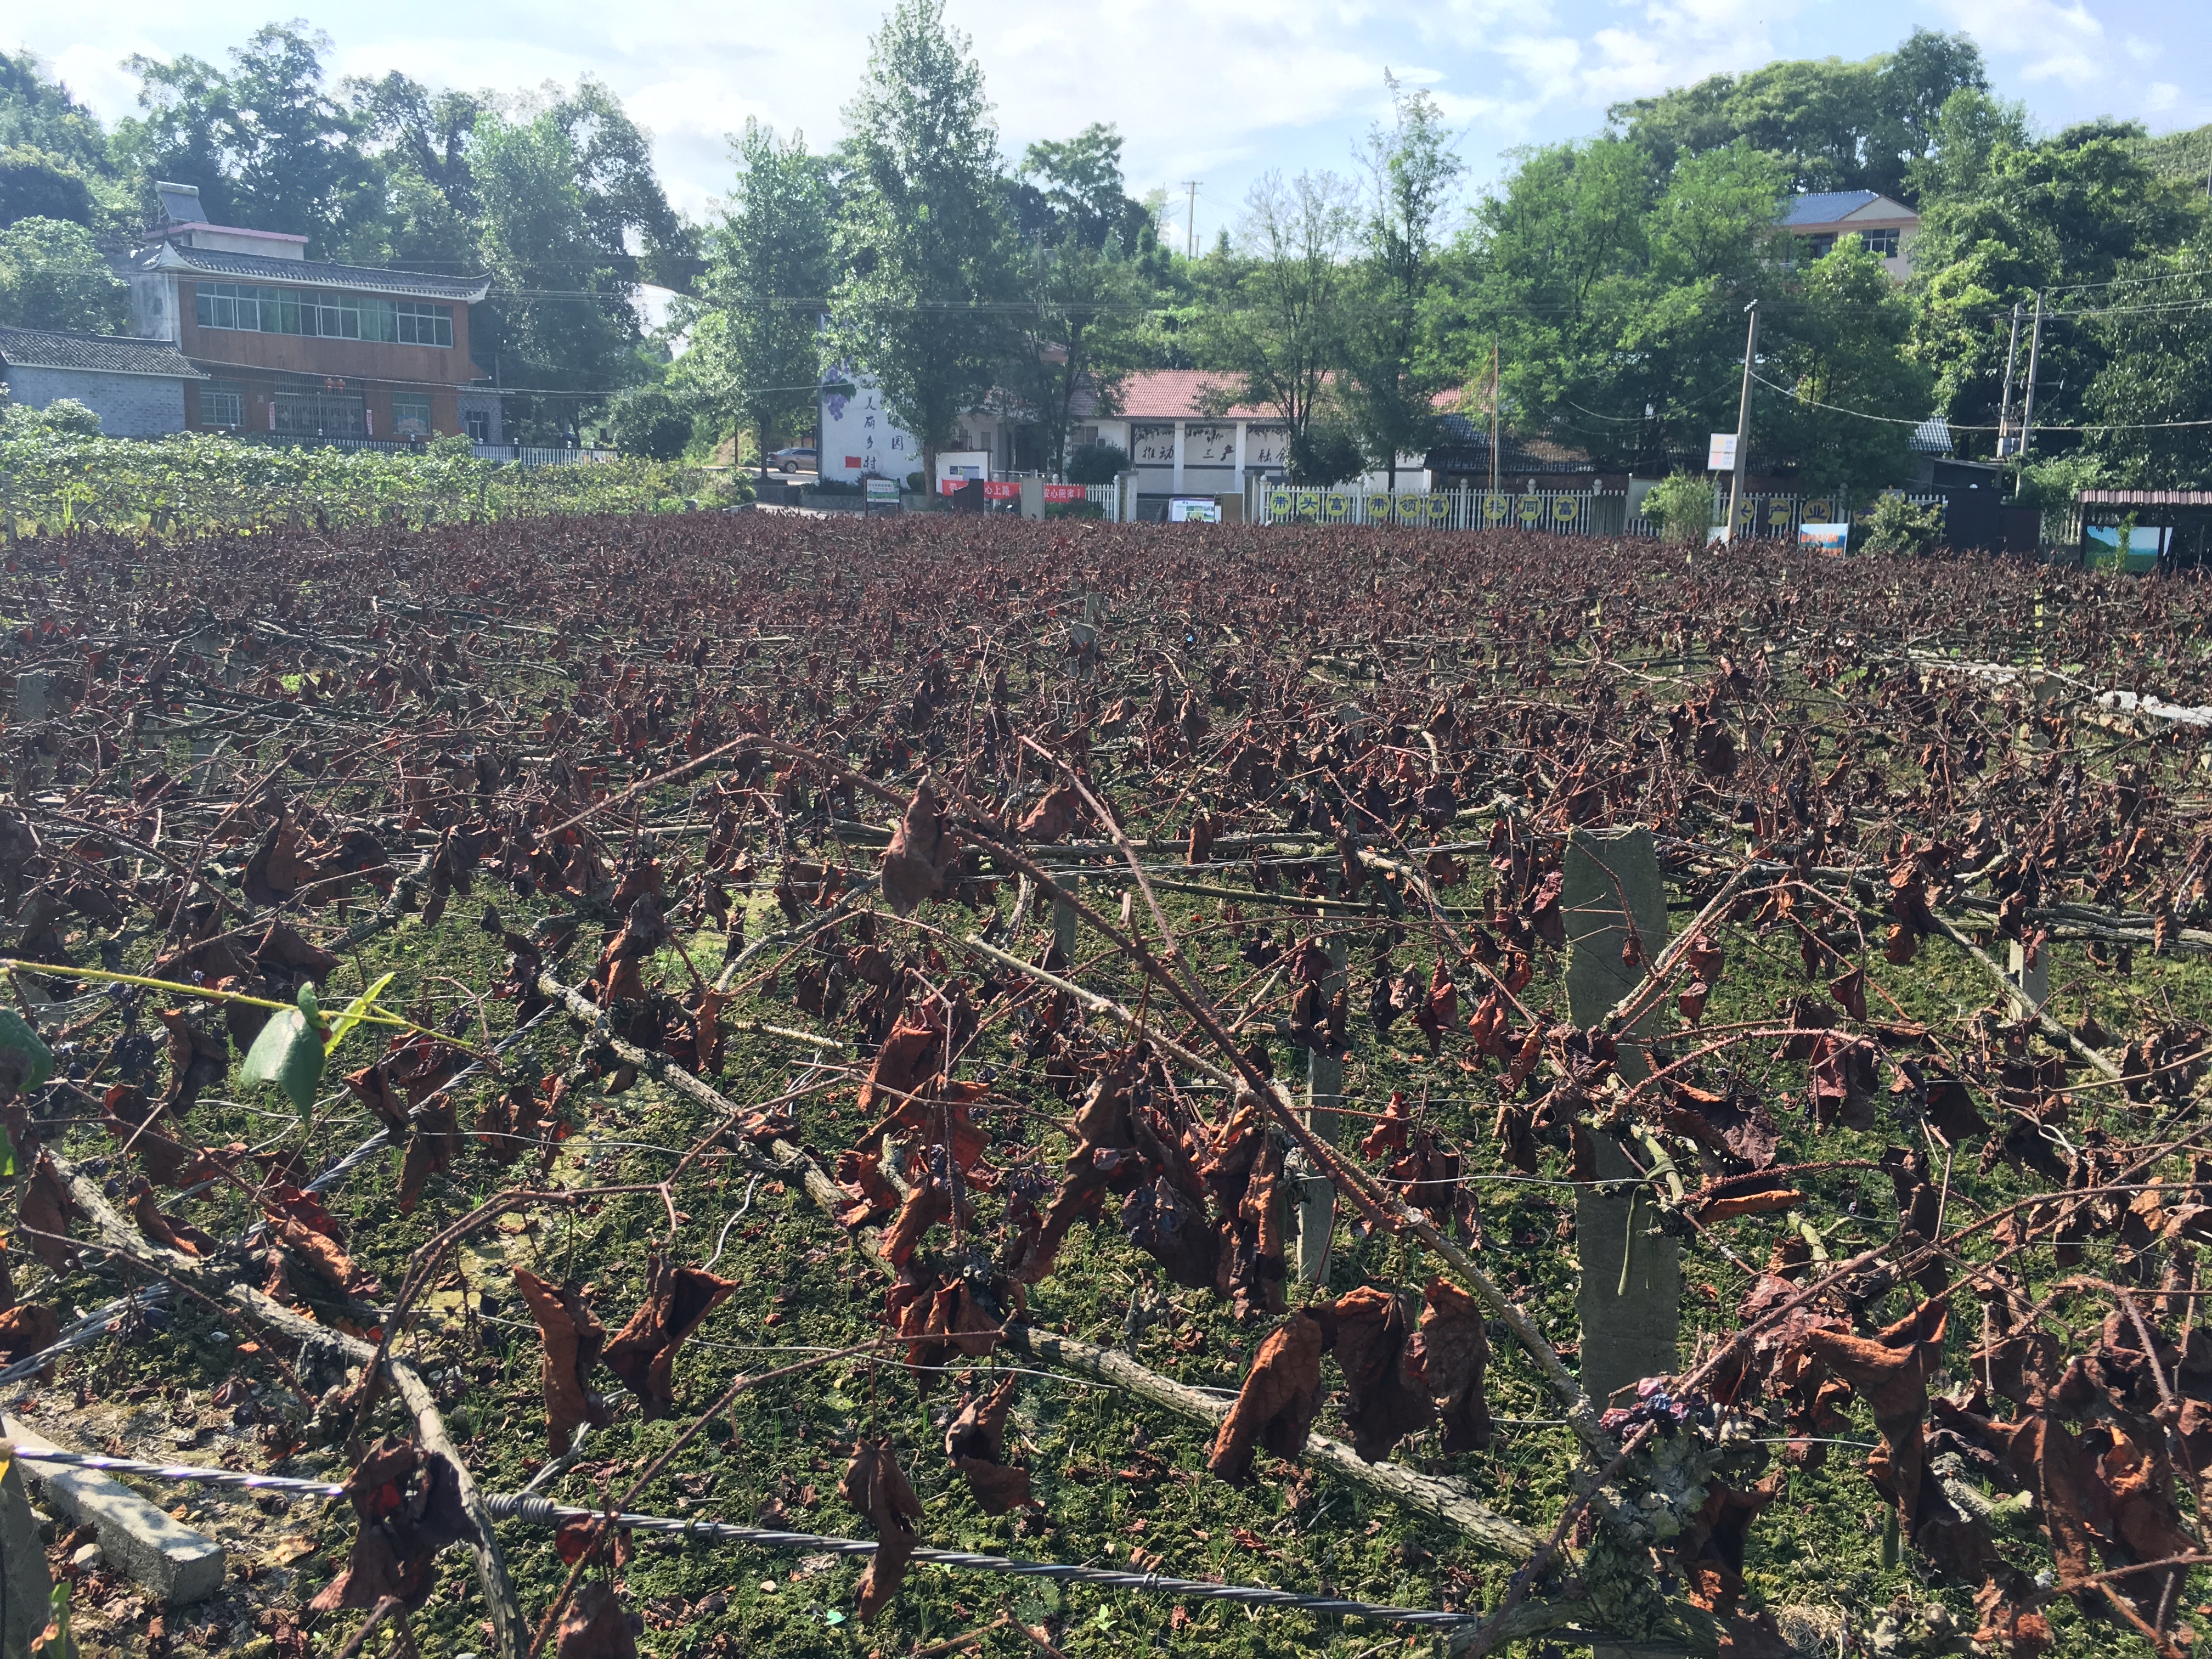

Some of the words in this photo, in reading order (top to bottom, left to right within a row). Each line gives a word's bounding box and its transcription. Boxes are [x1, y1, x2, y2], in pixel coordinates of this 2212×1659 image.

[1142, 444, 1175, 460] 推动
[1202, 444, 1234, 461] 三产
[1272, 495, 1345, 511] 带头富
[1371, 496, 1447, 513] 带领富
[1485, 500, 1576, 516] 共同富
